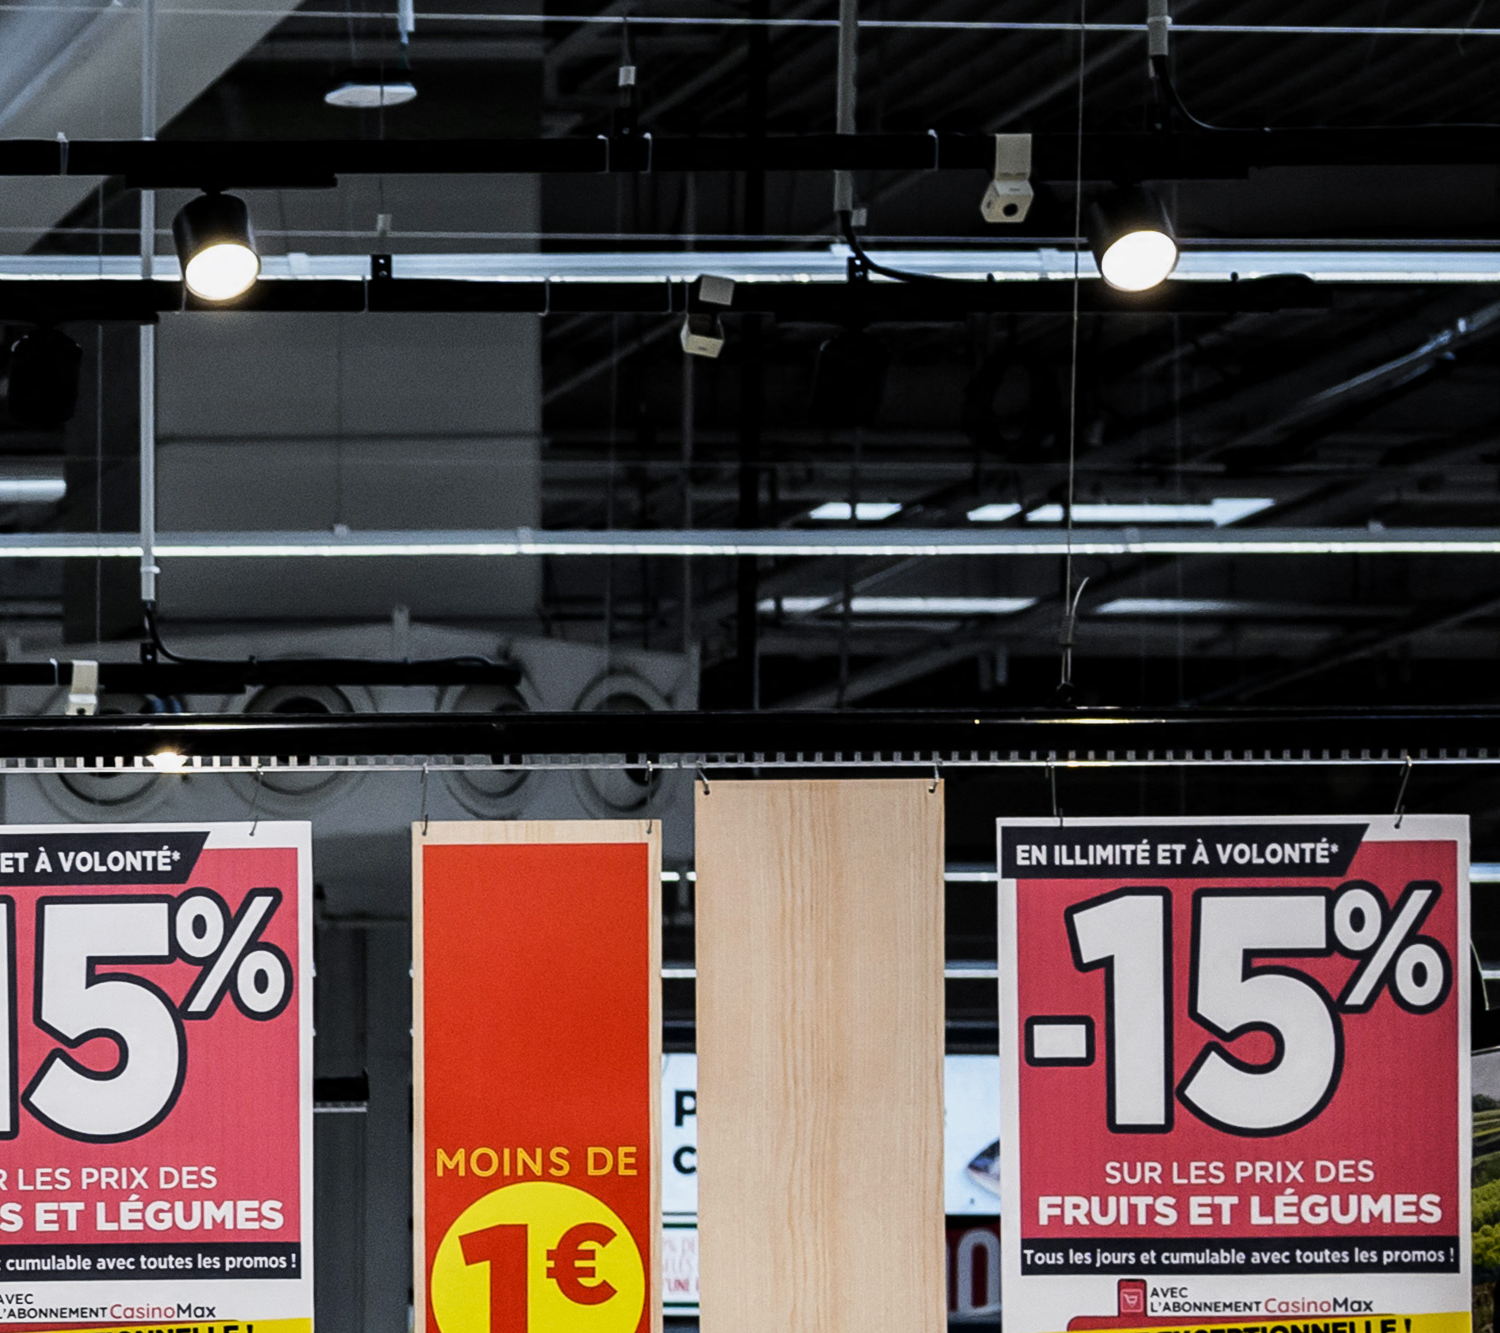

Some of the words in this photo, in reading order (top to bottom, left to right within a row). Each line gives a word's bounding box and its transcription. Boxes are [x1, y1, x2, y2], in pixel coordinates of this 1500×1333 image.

[0, 852, 28, 872] ET
[35, 847, 52, 872] À
[1025, 880, 1451, 1137] -15%
[18, 1168, 70, 1190] LES
[82, 1167, 148, 1189] PRIX
[160, 1166, 216, 1188] DES
[437, 1147, 570, 1177] MOINS
[587, 1147, 637, 1176] DE
[36, 1202, 84, 1231] ET
[97, 1195, 283, 1230] LÉGUMES
[1039, 1196, 1177, 1225] FRUITS
[1190, 1196, 1238, 1225] ET
[1251, 1188, 1441, 1224] LÉGUMES
